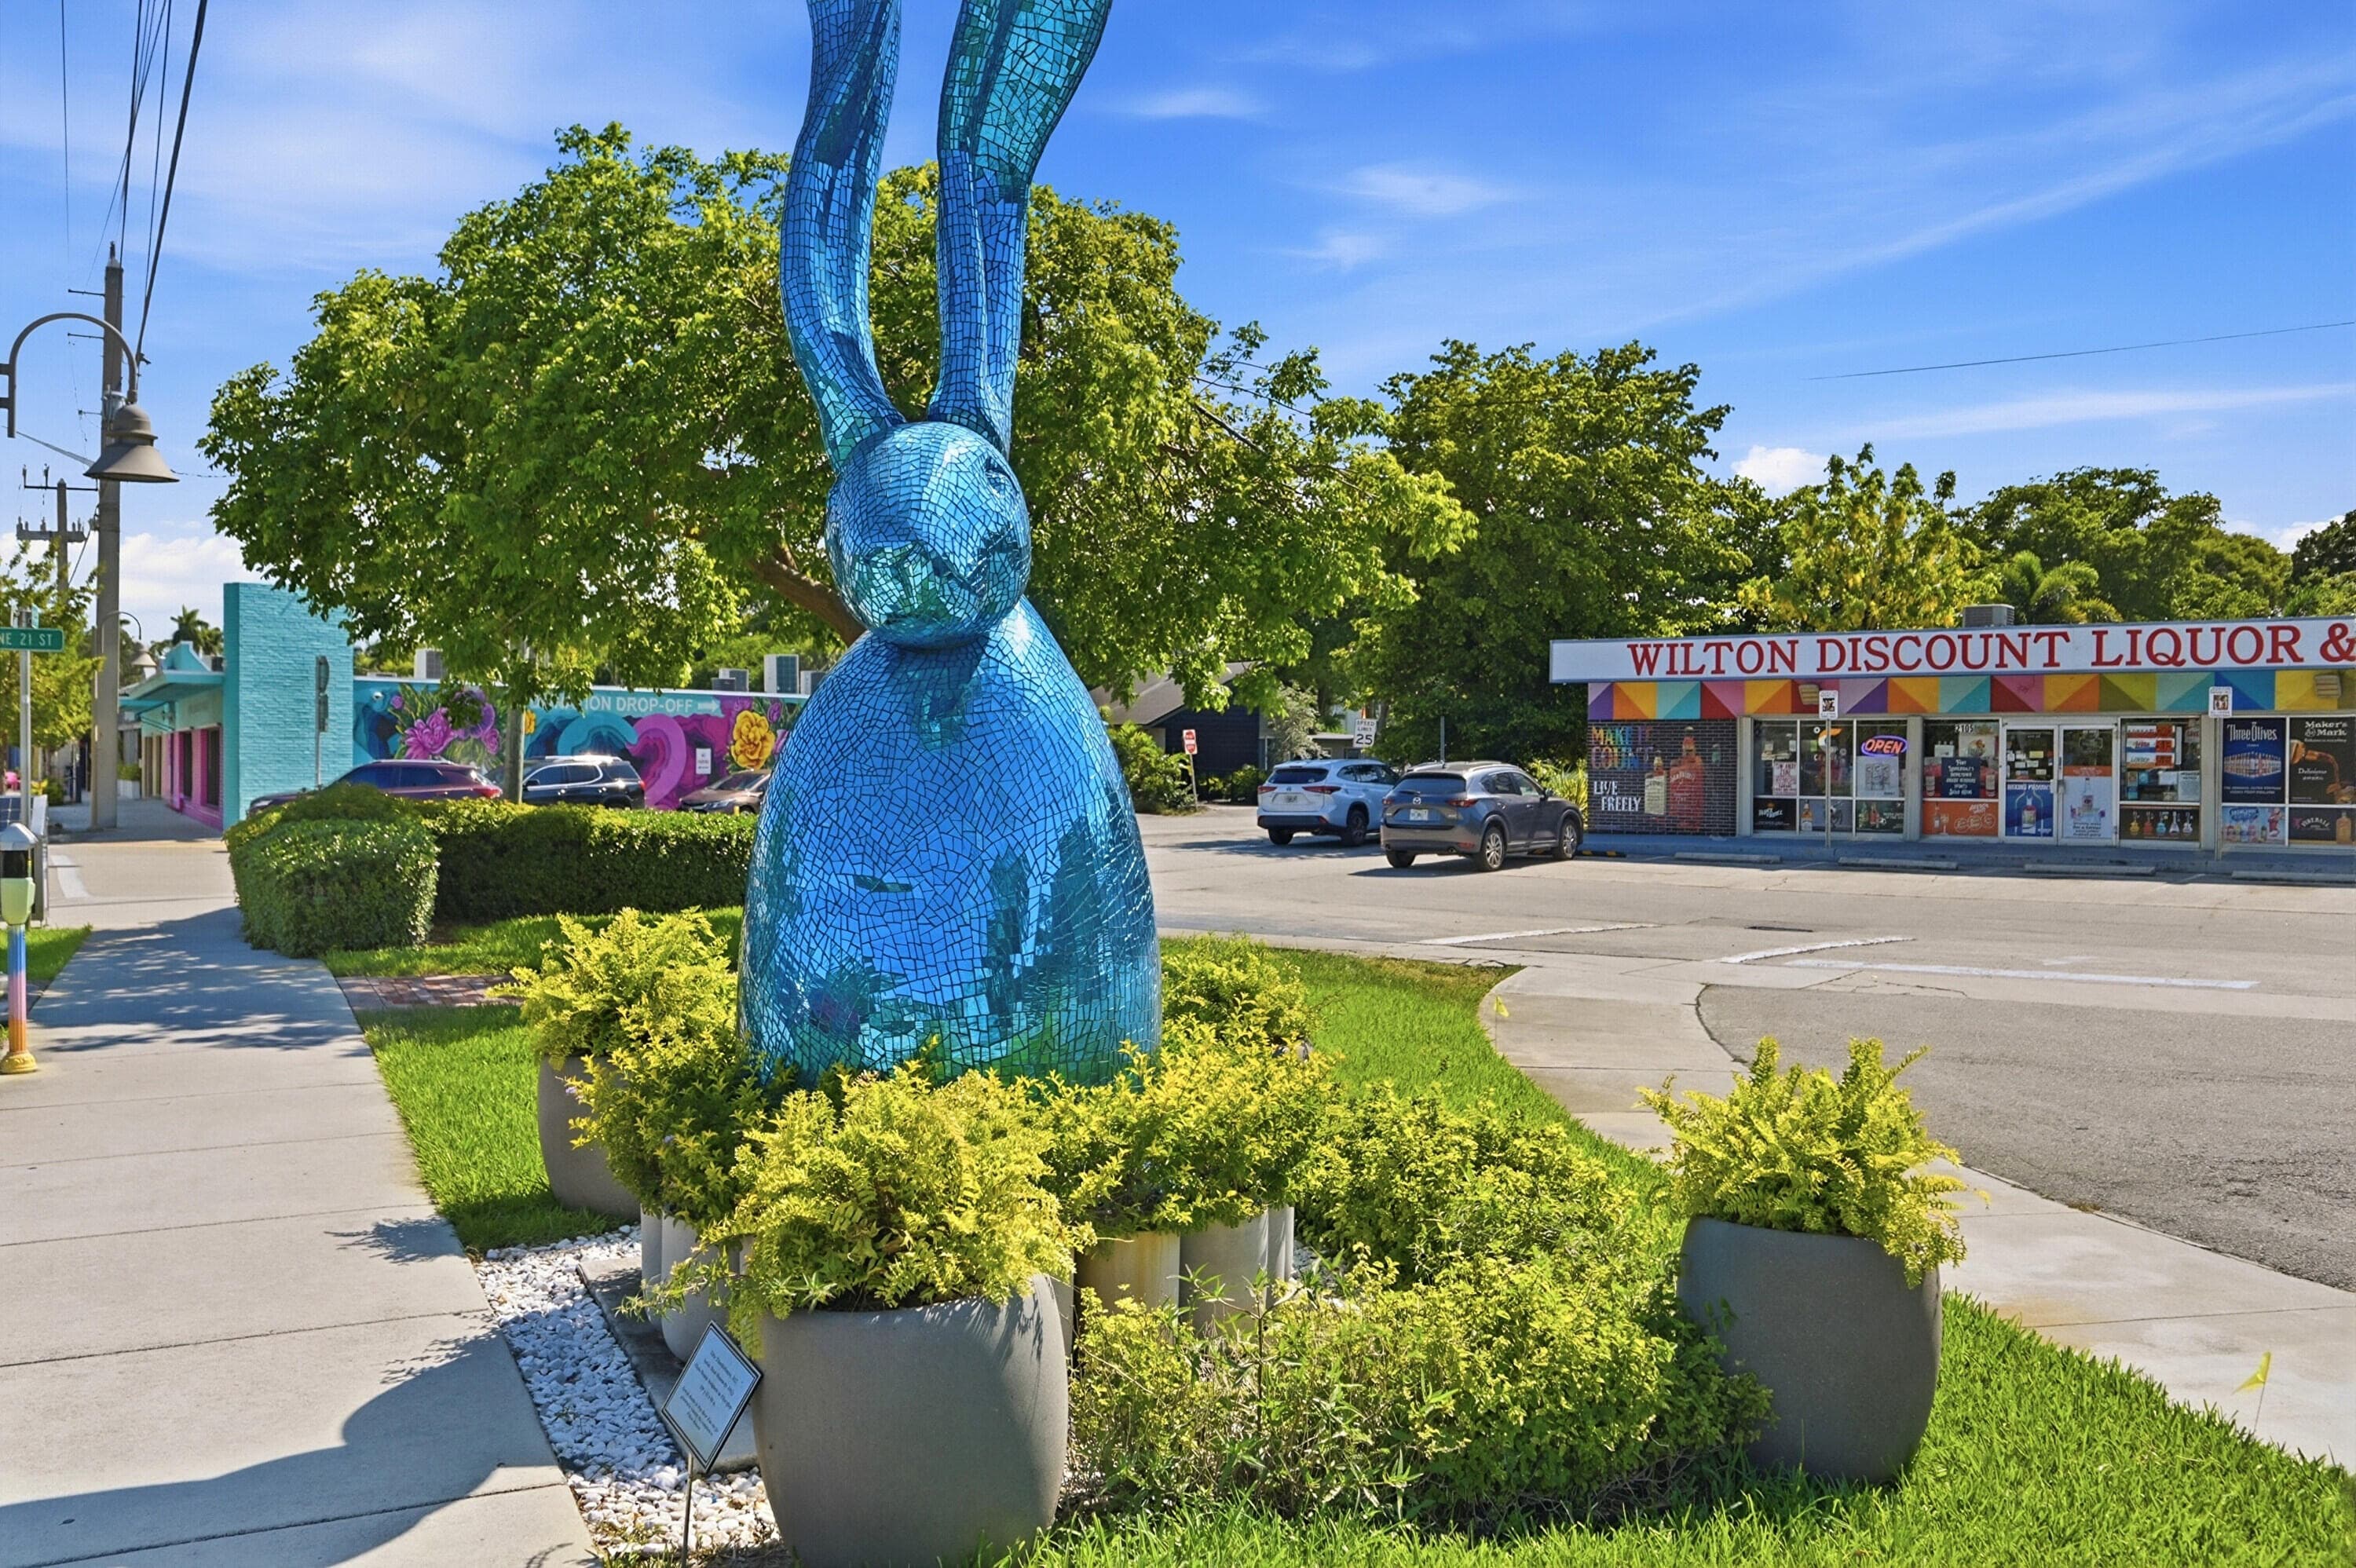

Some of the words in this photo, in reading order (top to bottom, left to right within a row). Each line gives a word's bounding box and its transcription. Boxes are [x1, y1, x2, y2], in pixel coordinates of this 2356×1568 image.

[0, 633, 12, 645] NE
[20, 634, 31, 645] 21
[38, 634, 52, 646] ST
[1627, 640, 1799, 676] WILTON
[1816, 630, 2070, 673] DISCOUNT
[2091, 625, 2305, 667] LIQUOR
[2319, 623, 2356, 663] &
[616, 696, 693, 712] DROP-OFF
[2226, 723, 2251, 741] Three
[2252, 722, 2278, 741] Olives
[2305, 721, 2348, 729] Maker's
[1356, 733, 1373, 745] 25
[1592, 726, 1633, 746] MAKE
[1864, 738, 1903, 755] OPEN
[1593, 780, 1619, 795] LIVE
[1601, 796, 1642, 812] FREELY
